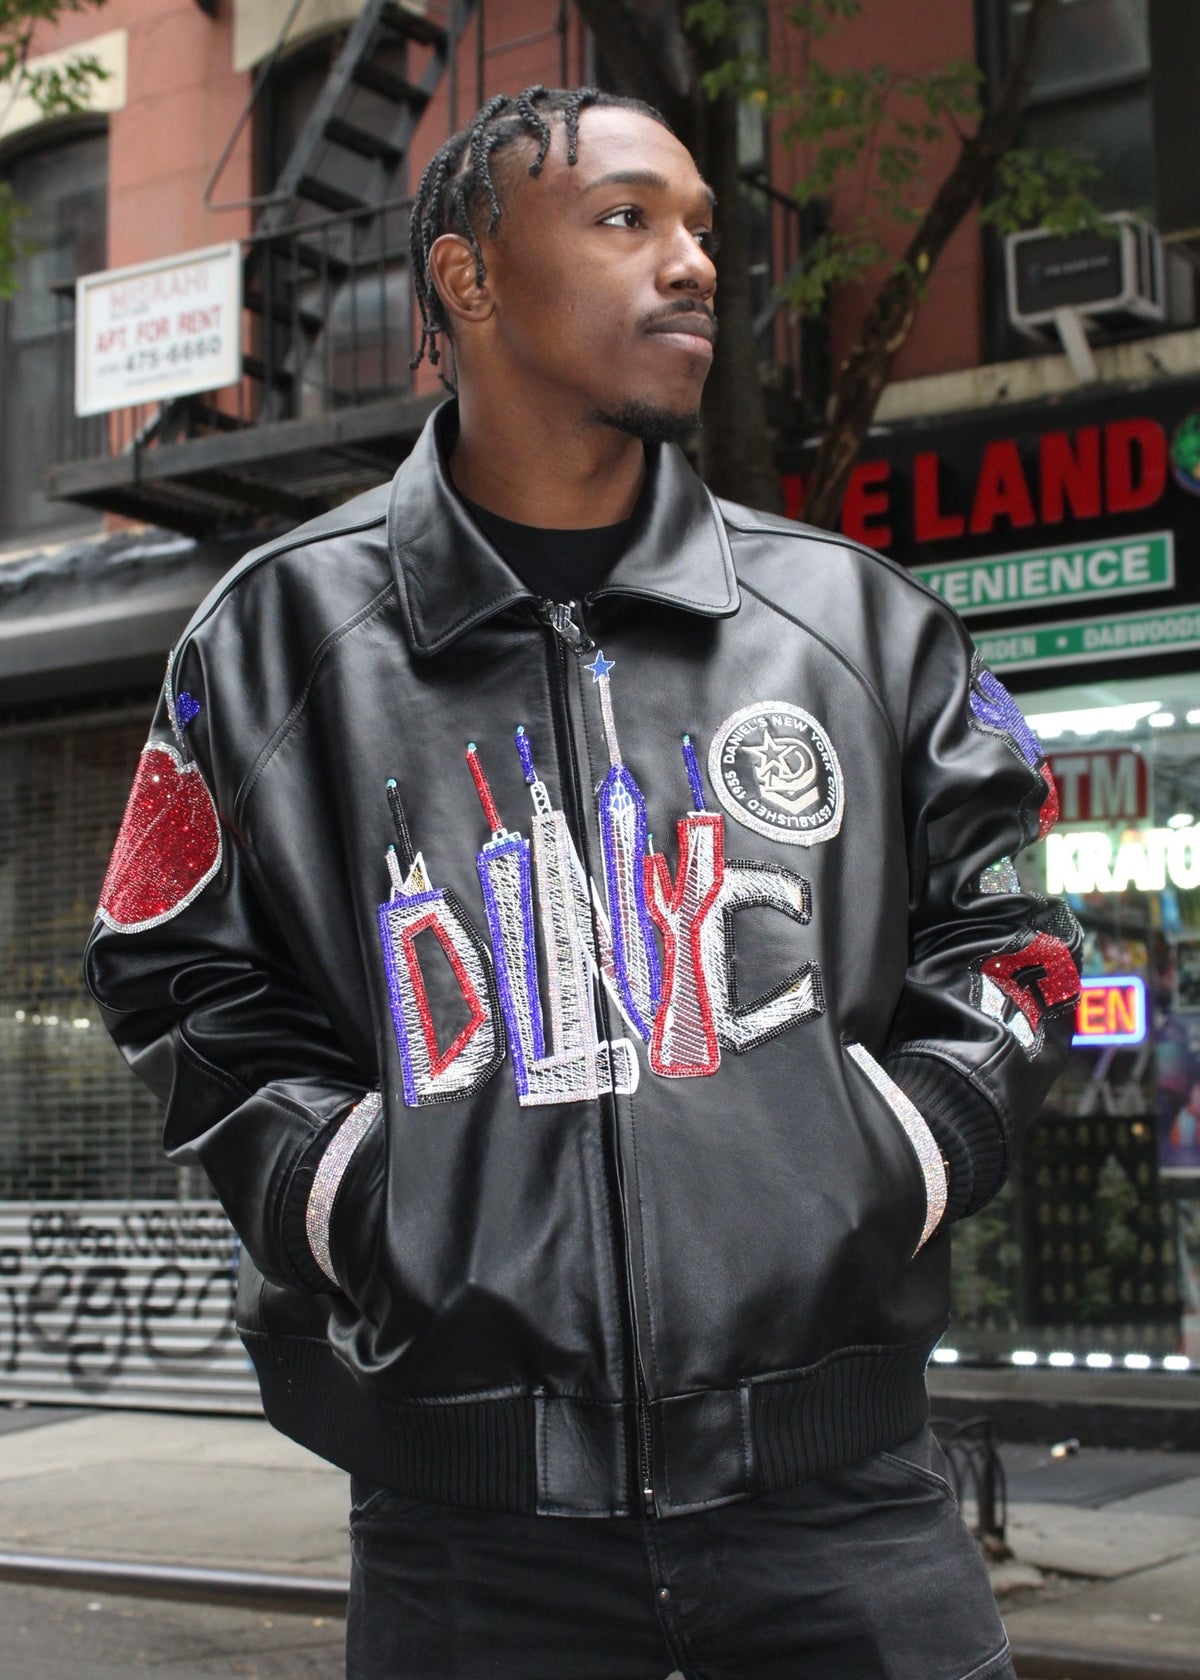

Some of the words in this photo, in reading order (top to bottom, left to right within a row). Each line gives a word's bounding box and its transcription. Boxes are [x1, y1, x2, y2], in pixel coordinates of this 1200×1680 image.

[135, 315, 169, 344] FOR
[177, 303, 222, 335] RENT
[914, 418, 1167, 542] LAND
[723, 716, 768, 765] DANIEL'S
[772, 714, 808, 732] NEW
[810, 731, 833, 773] YORK
[724, 770, 747, 799] 1955
[747, 799, 833, 828] ESTABLISHED
